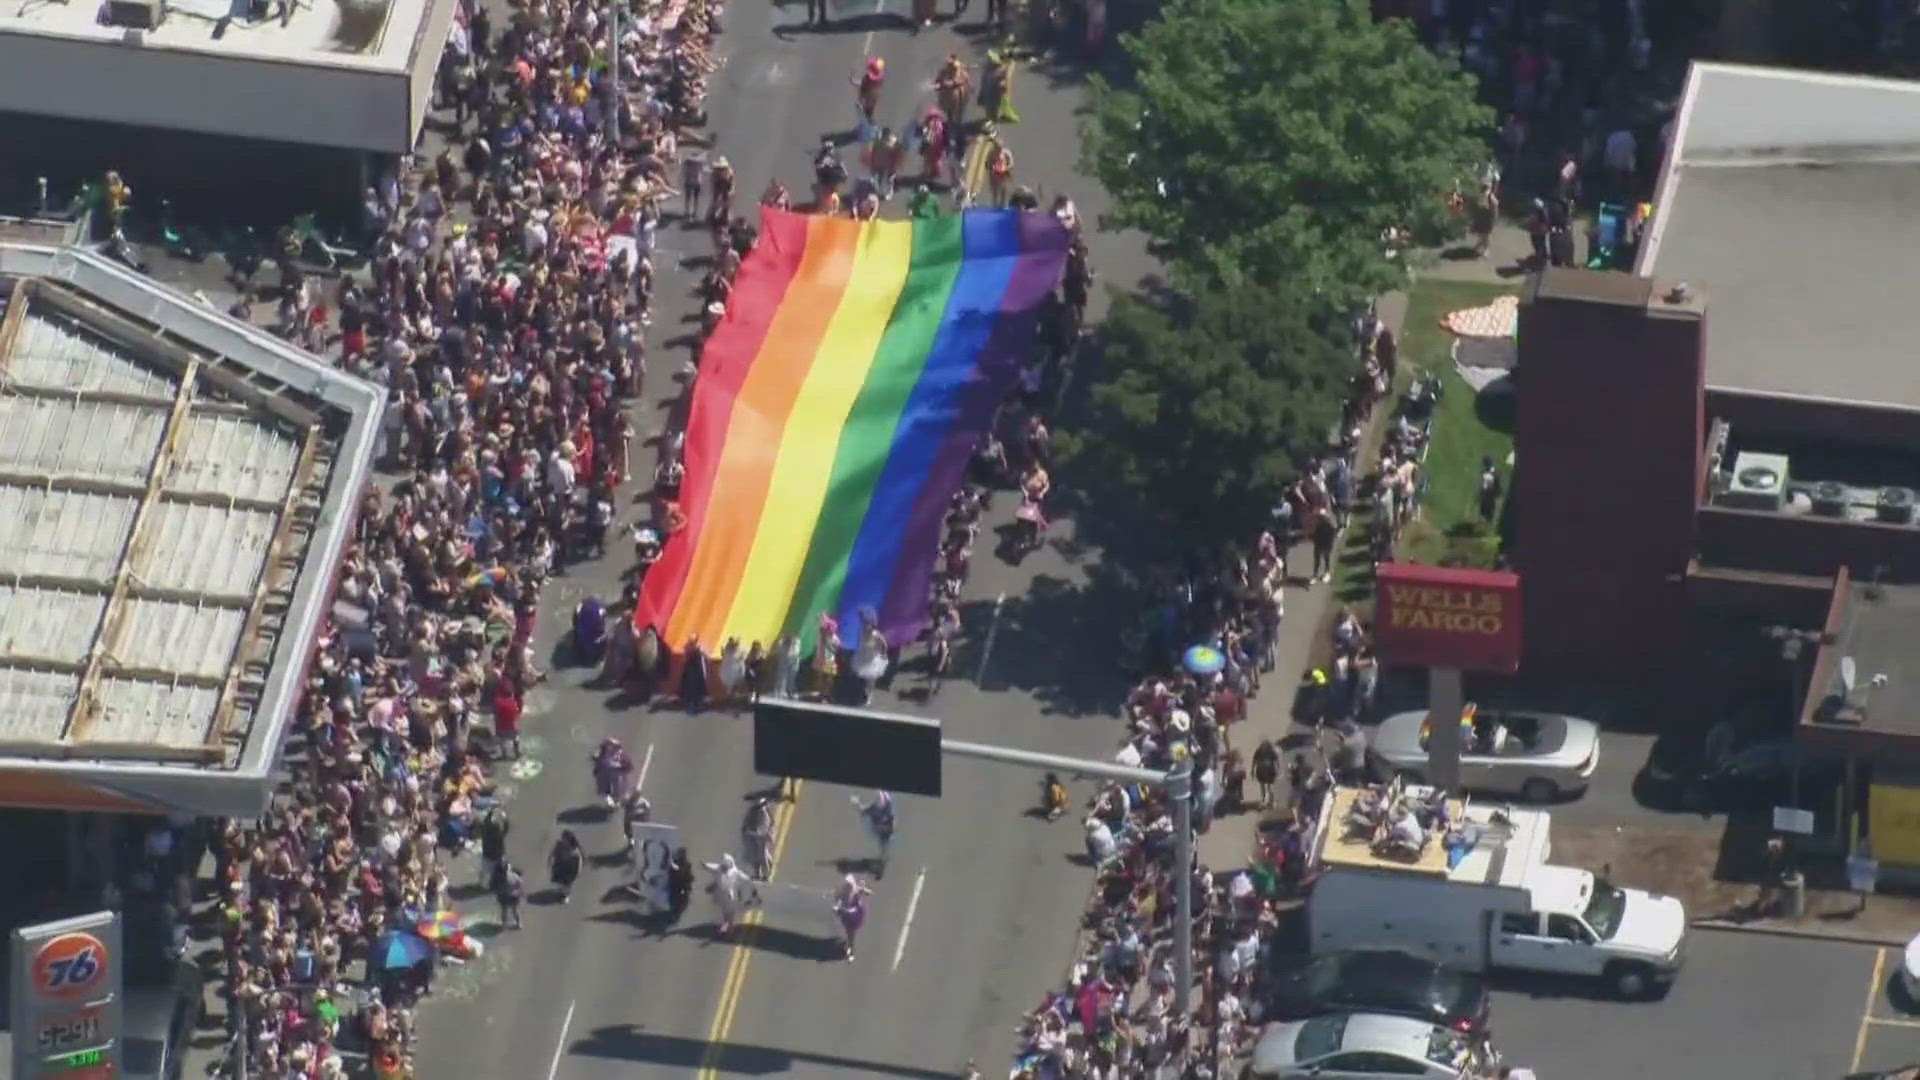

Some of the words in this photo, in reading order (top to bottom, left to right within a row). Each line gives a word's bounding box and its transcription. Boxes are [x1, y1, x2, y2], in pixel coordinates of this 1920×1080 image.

[1385, 585, 1502, 612] WELLS
[1391, 608, 1502, 634] FARGO
[47, 945, 97, 987] 76
